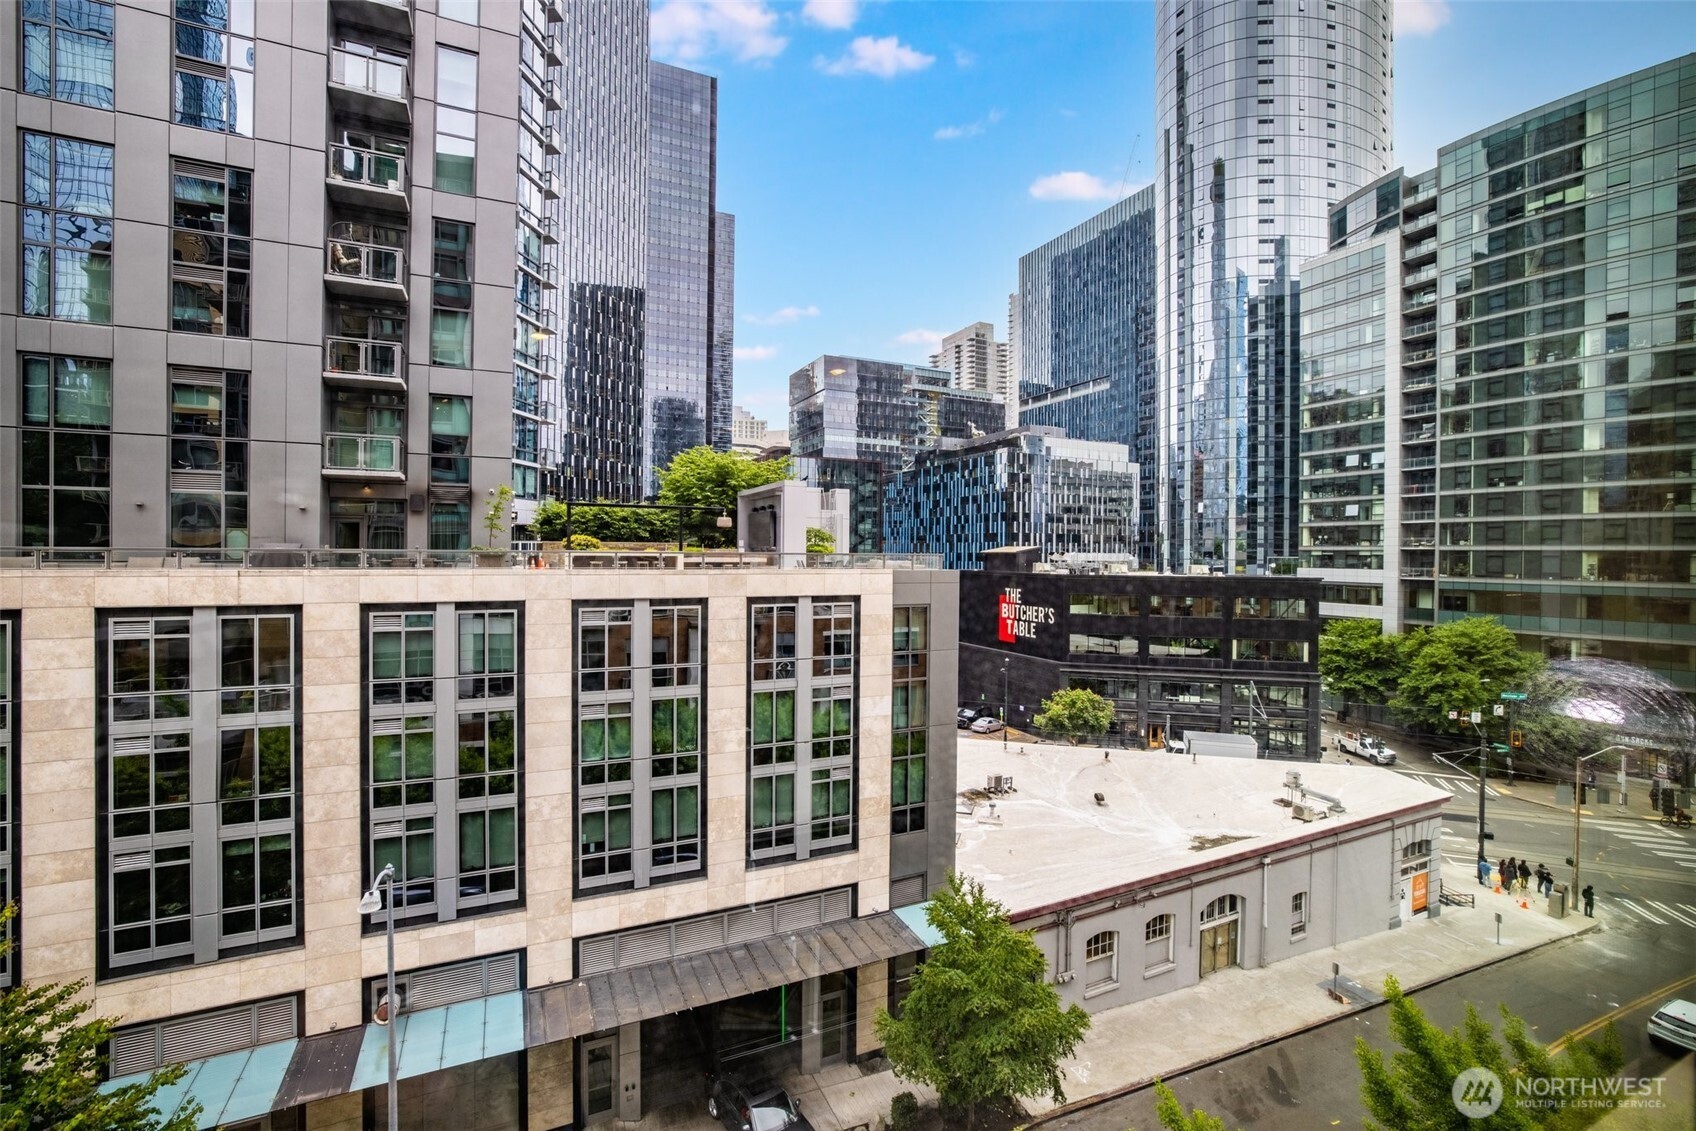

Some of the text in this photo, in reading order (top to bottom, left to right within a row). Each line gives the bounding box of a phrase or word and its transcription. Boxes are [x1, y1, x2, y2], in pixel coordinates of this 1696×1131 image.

[1005, 587, 1022, 603] THE
[1001, 603, 1055, 624] BUTCHER'S
[1006, 619, 1036, 638] TABLE
